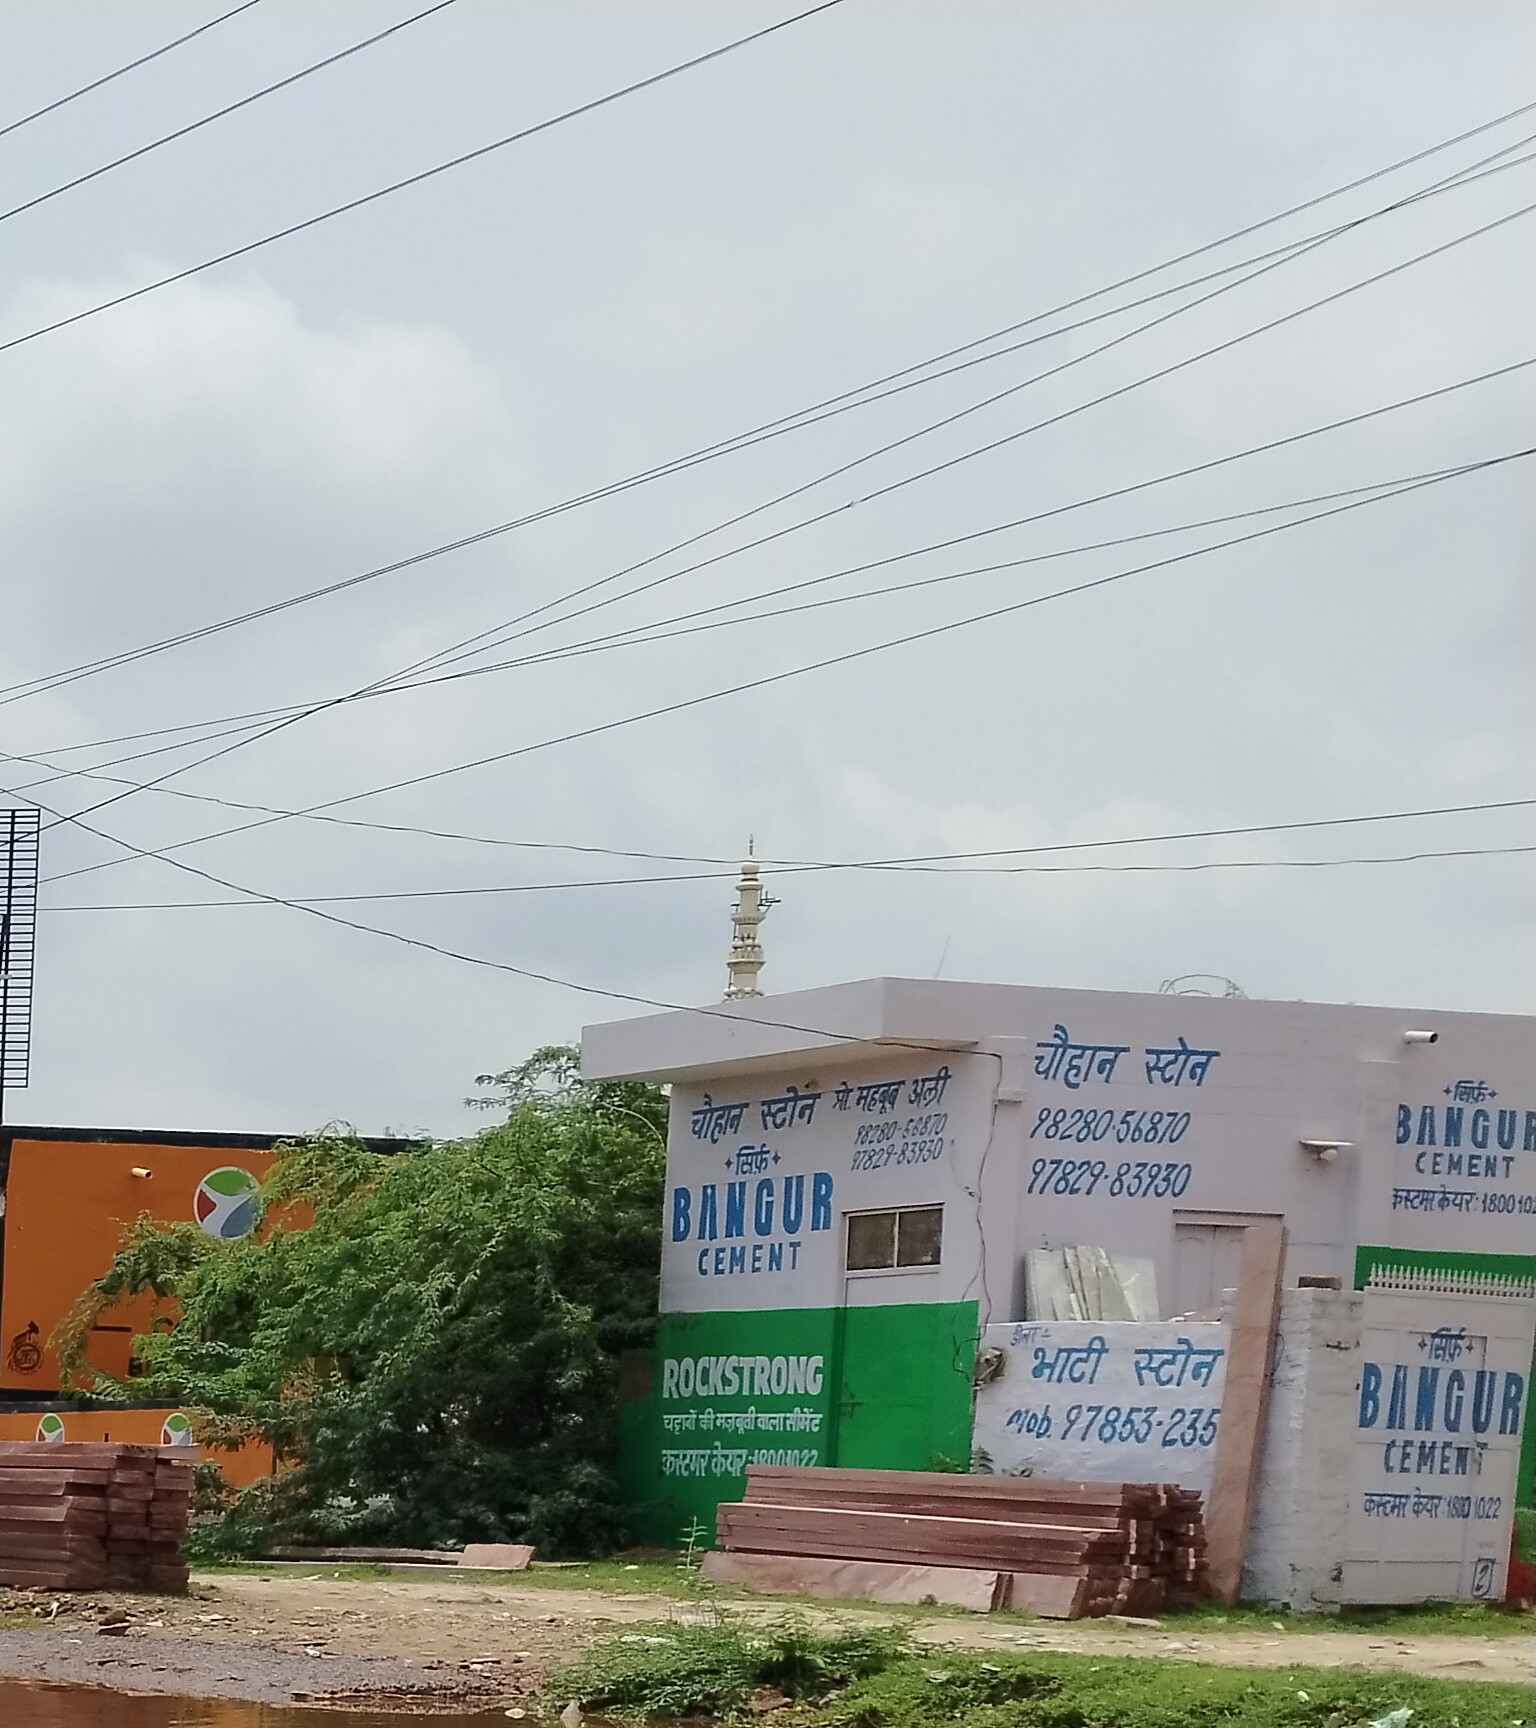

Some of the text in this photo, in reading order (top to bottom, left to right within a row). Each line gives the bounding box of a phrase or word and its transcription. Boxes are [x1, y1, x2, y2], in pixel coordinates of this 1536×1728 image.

[1034, 1024, 1221, 1089] चौहान स्टोन
[761, 1086, 823, 1130] स्टोन
[1415, 1151, 1515, 1179] CEMENT
[672, 1172, 835, 1242] BANGUR
[698, 1241, 802, 1276] CEMENT
[662, 1355, 824, 1398] ROCKSTRONG
[1031, 1335, 1225, 1387] भाटी स्टोन
[1358, 1361, 1525, 1436] BANGUR
[1383, 1438, 1488, 1476] CEMENT
